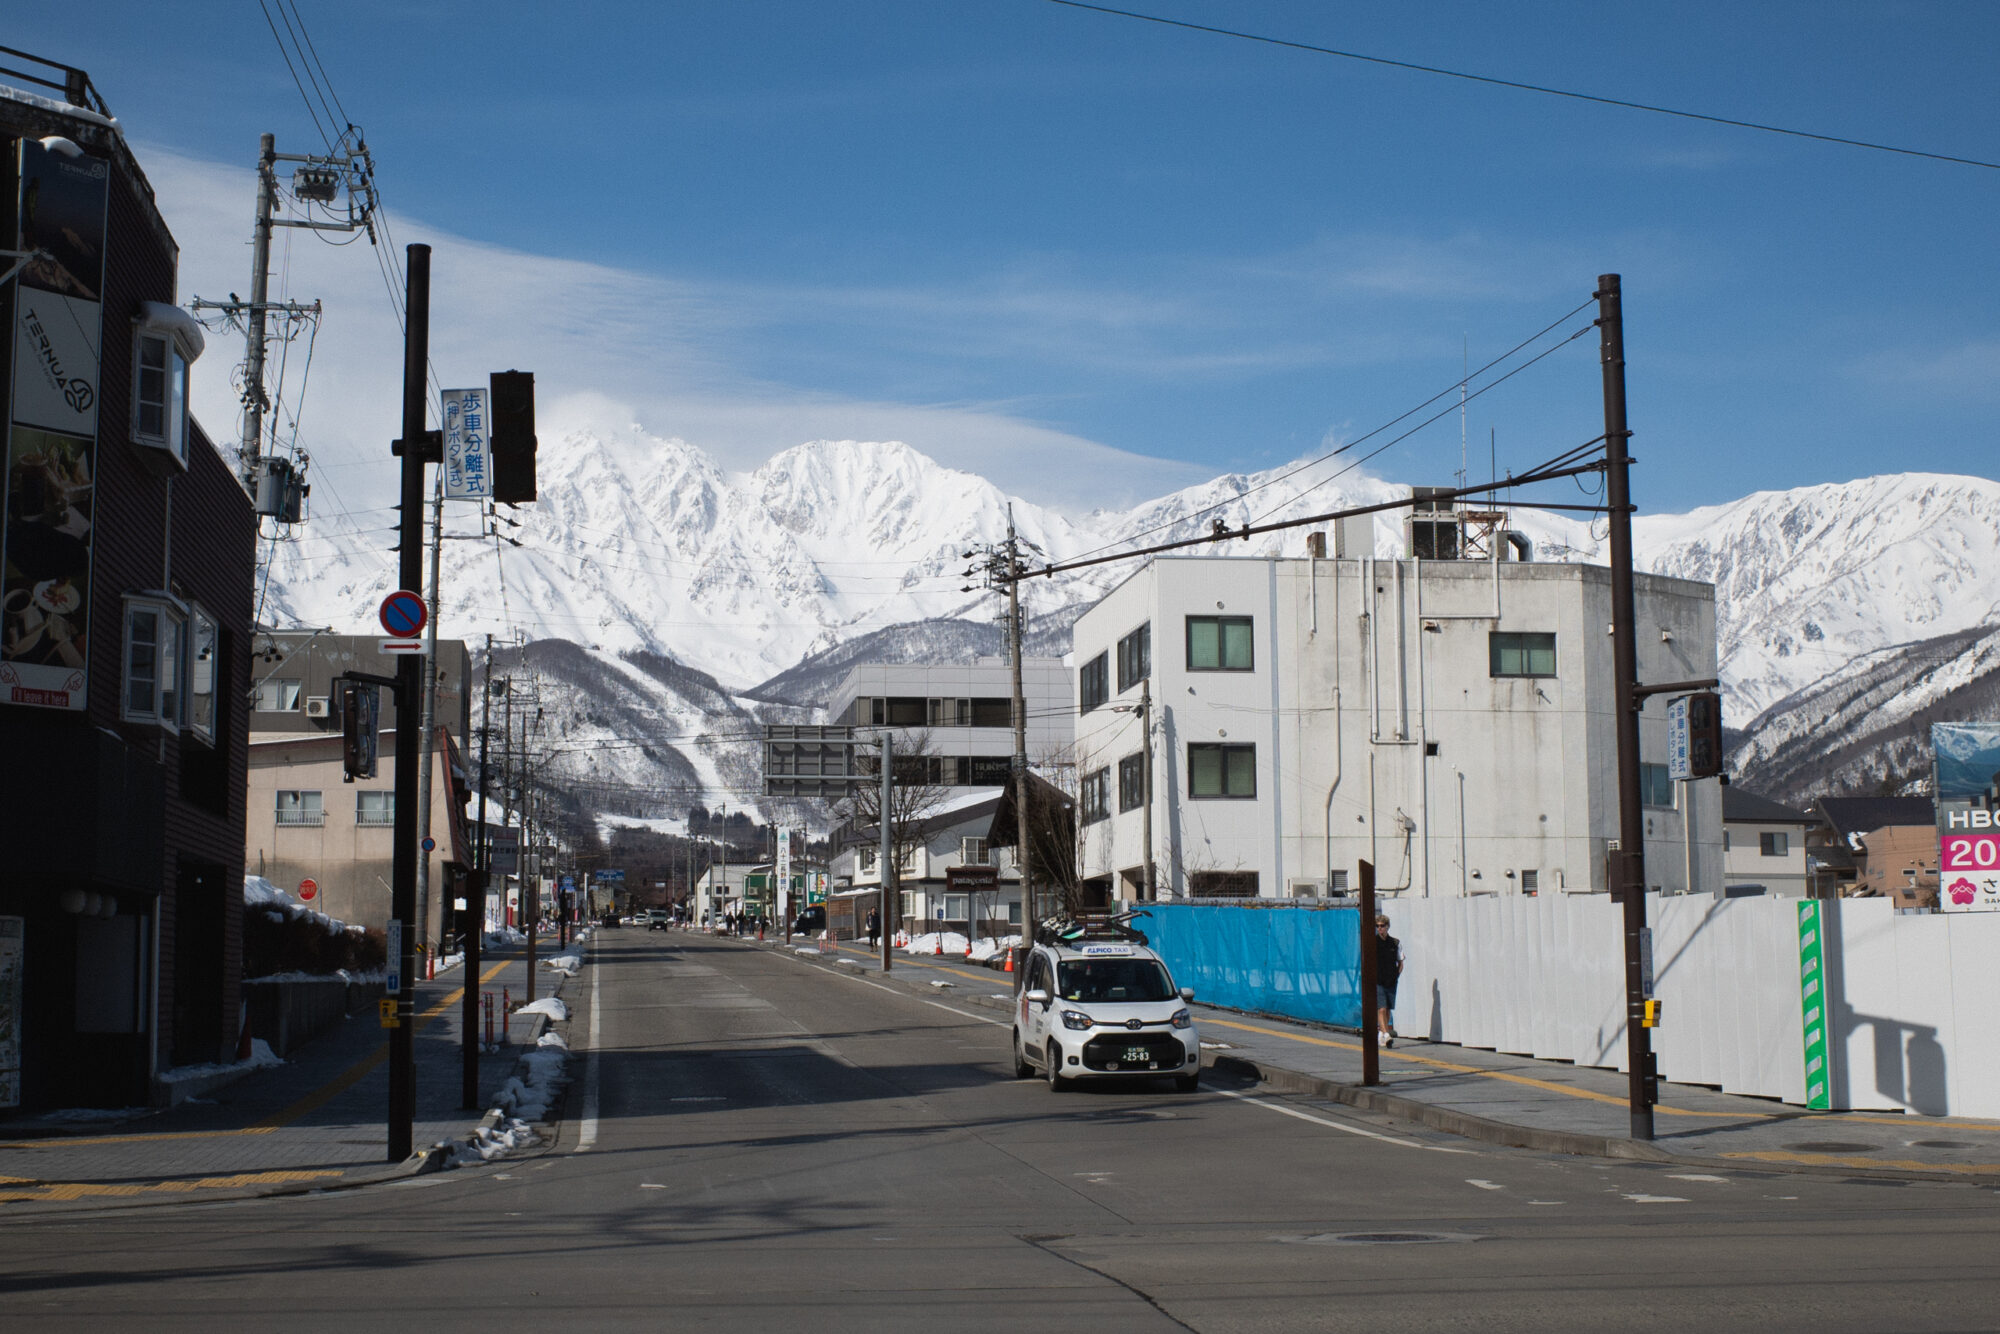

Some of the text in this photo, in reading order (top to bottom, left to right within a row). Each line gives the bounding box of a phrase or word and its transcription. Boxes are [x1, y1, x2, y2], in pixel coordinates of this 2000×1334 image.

[25, 308, 67, 389] TERNUA
[446, 400, 463, 488] (押しボタン式)
[462, 393, 485, 493] 歩車分離式
[952, 876, 993, 887] patagonia
[1127, 1051, 1150, 1061] 25-83
